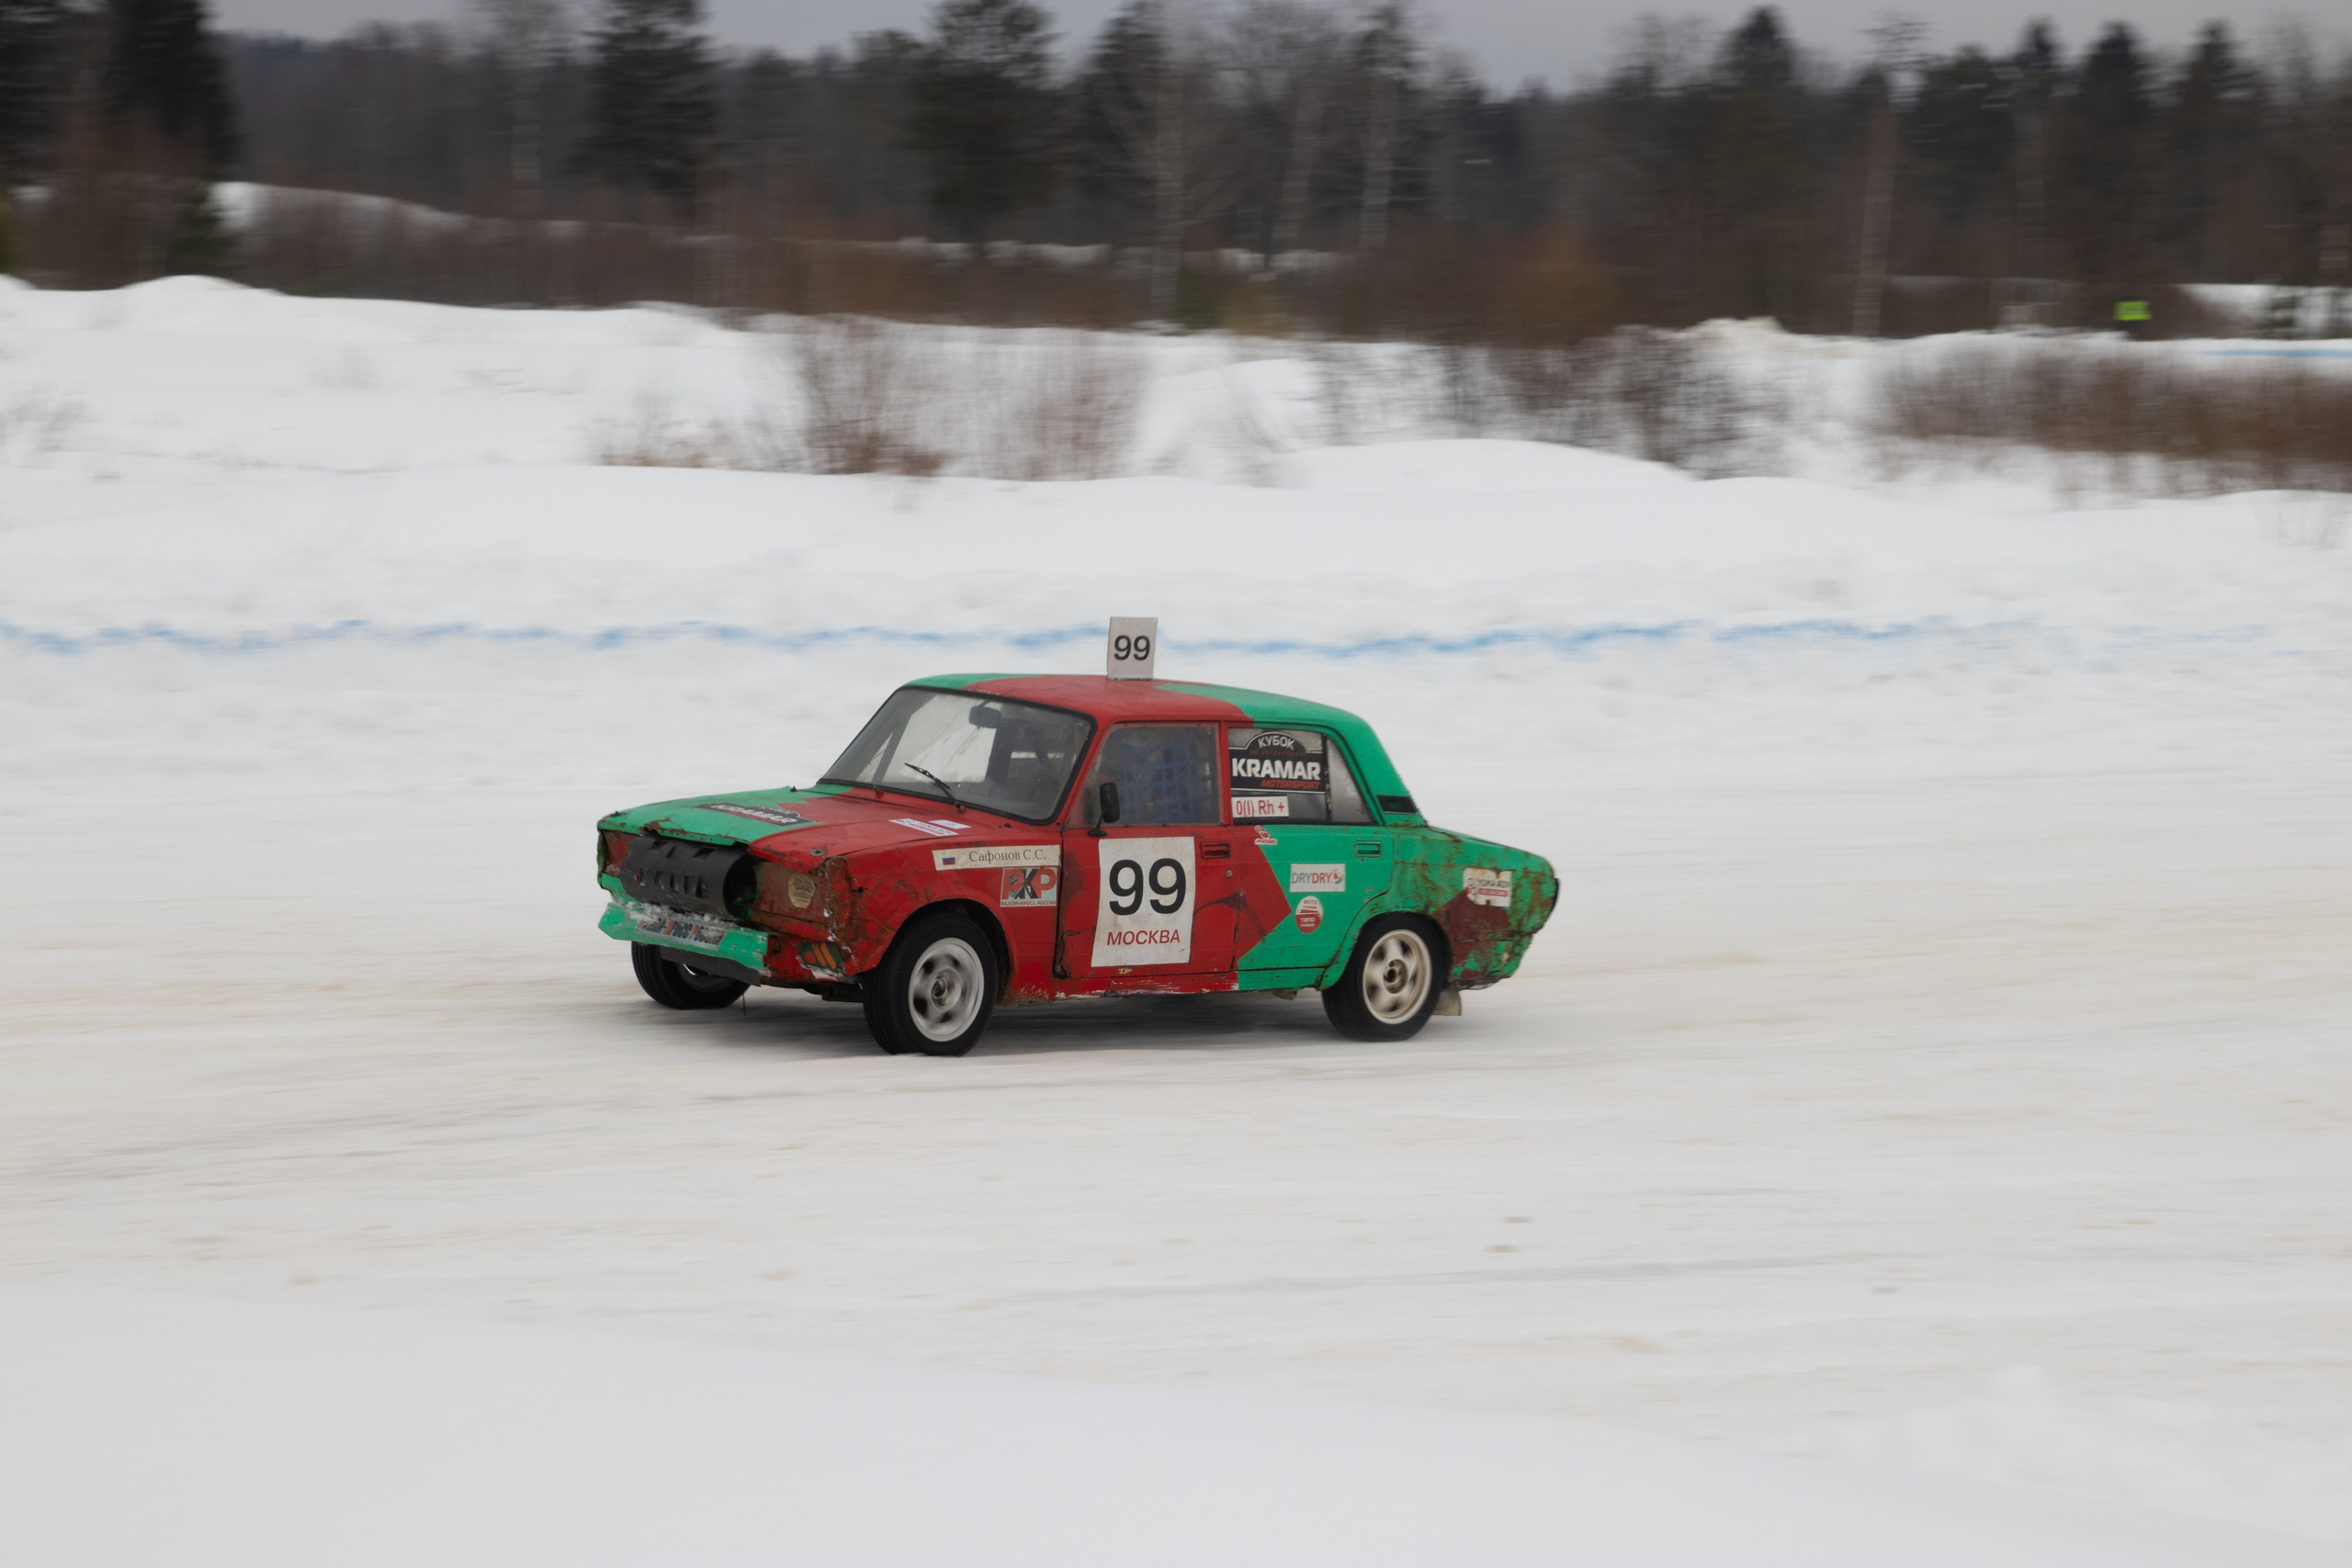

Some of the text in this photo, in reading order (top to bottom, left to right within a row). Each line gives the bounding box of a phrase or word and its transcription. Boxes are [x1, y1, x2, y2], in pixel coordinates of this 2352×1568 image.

[1114, 635, 1150, 661] 99
[1257, 735, 1295, 750] КУБОК
[1231, 758, 1321, 780] KRAMAR
[1261, 779, 1321, 789] MOTORSPORT
[1258, 800, 1274, 815] Rh
[968, 849, 1046, 863] Сафонов С.С.
[1109, 858, 1186, 916] 99
[1106, 930, 1181, 946] МОСКВА
